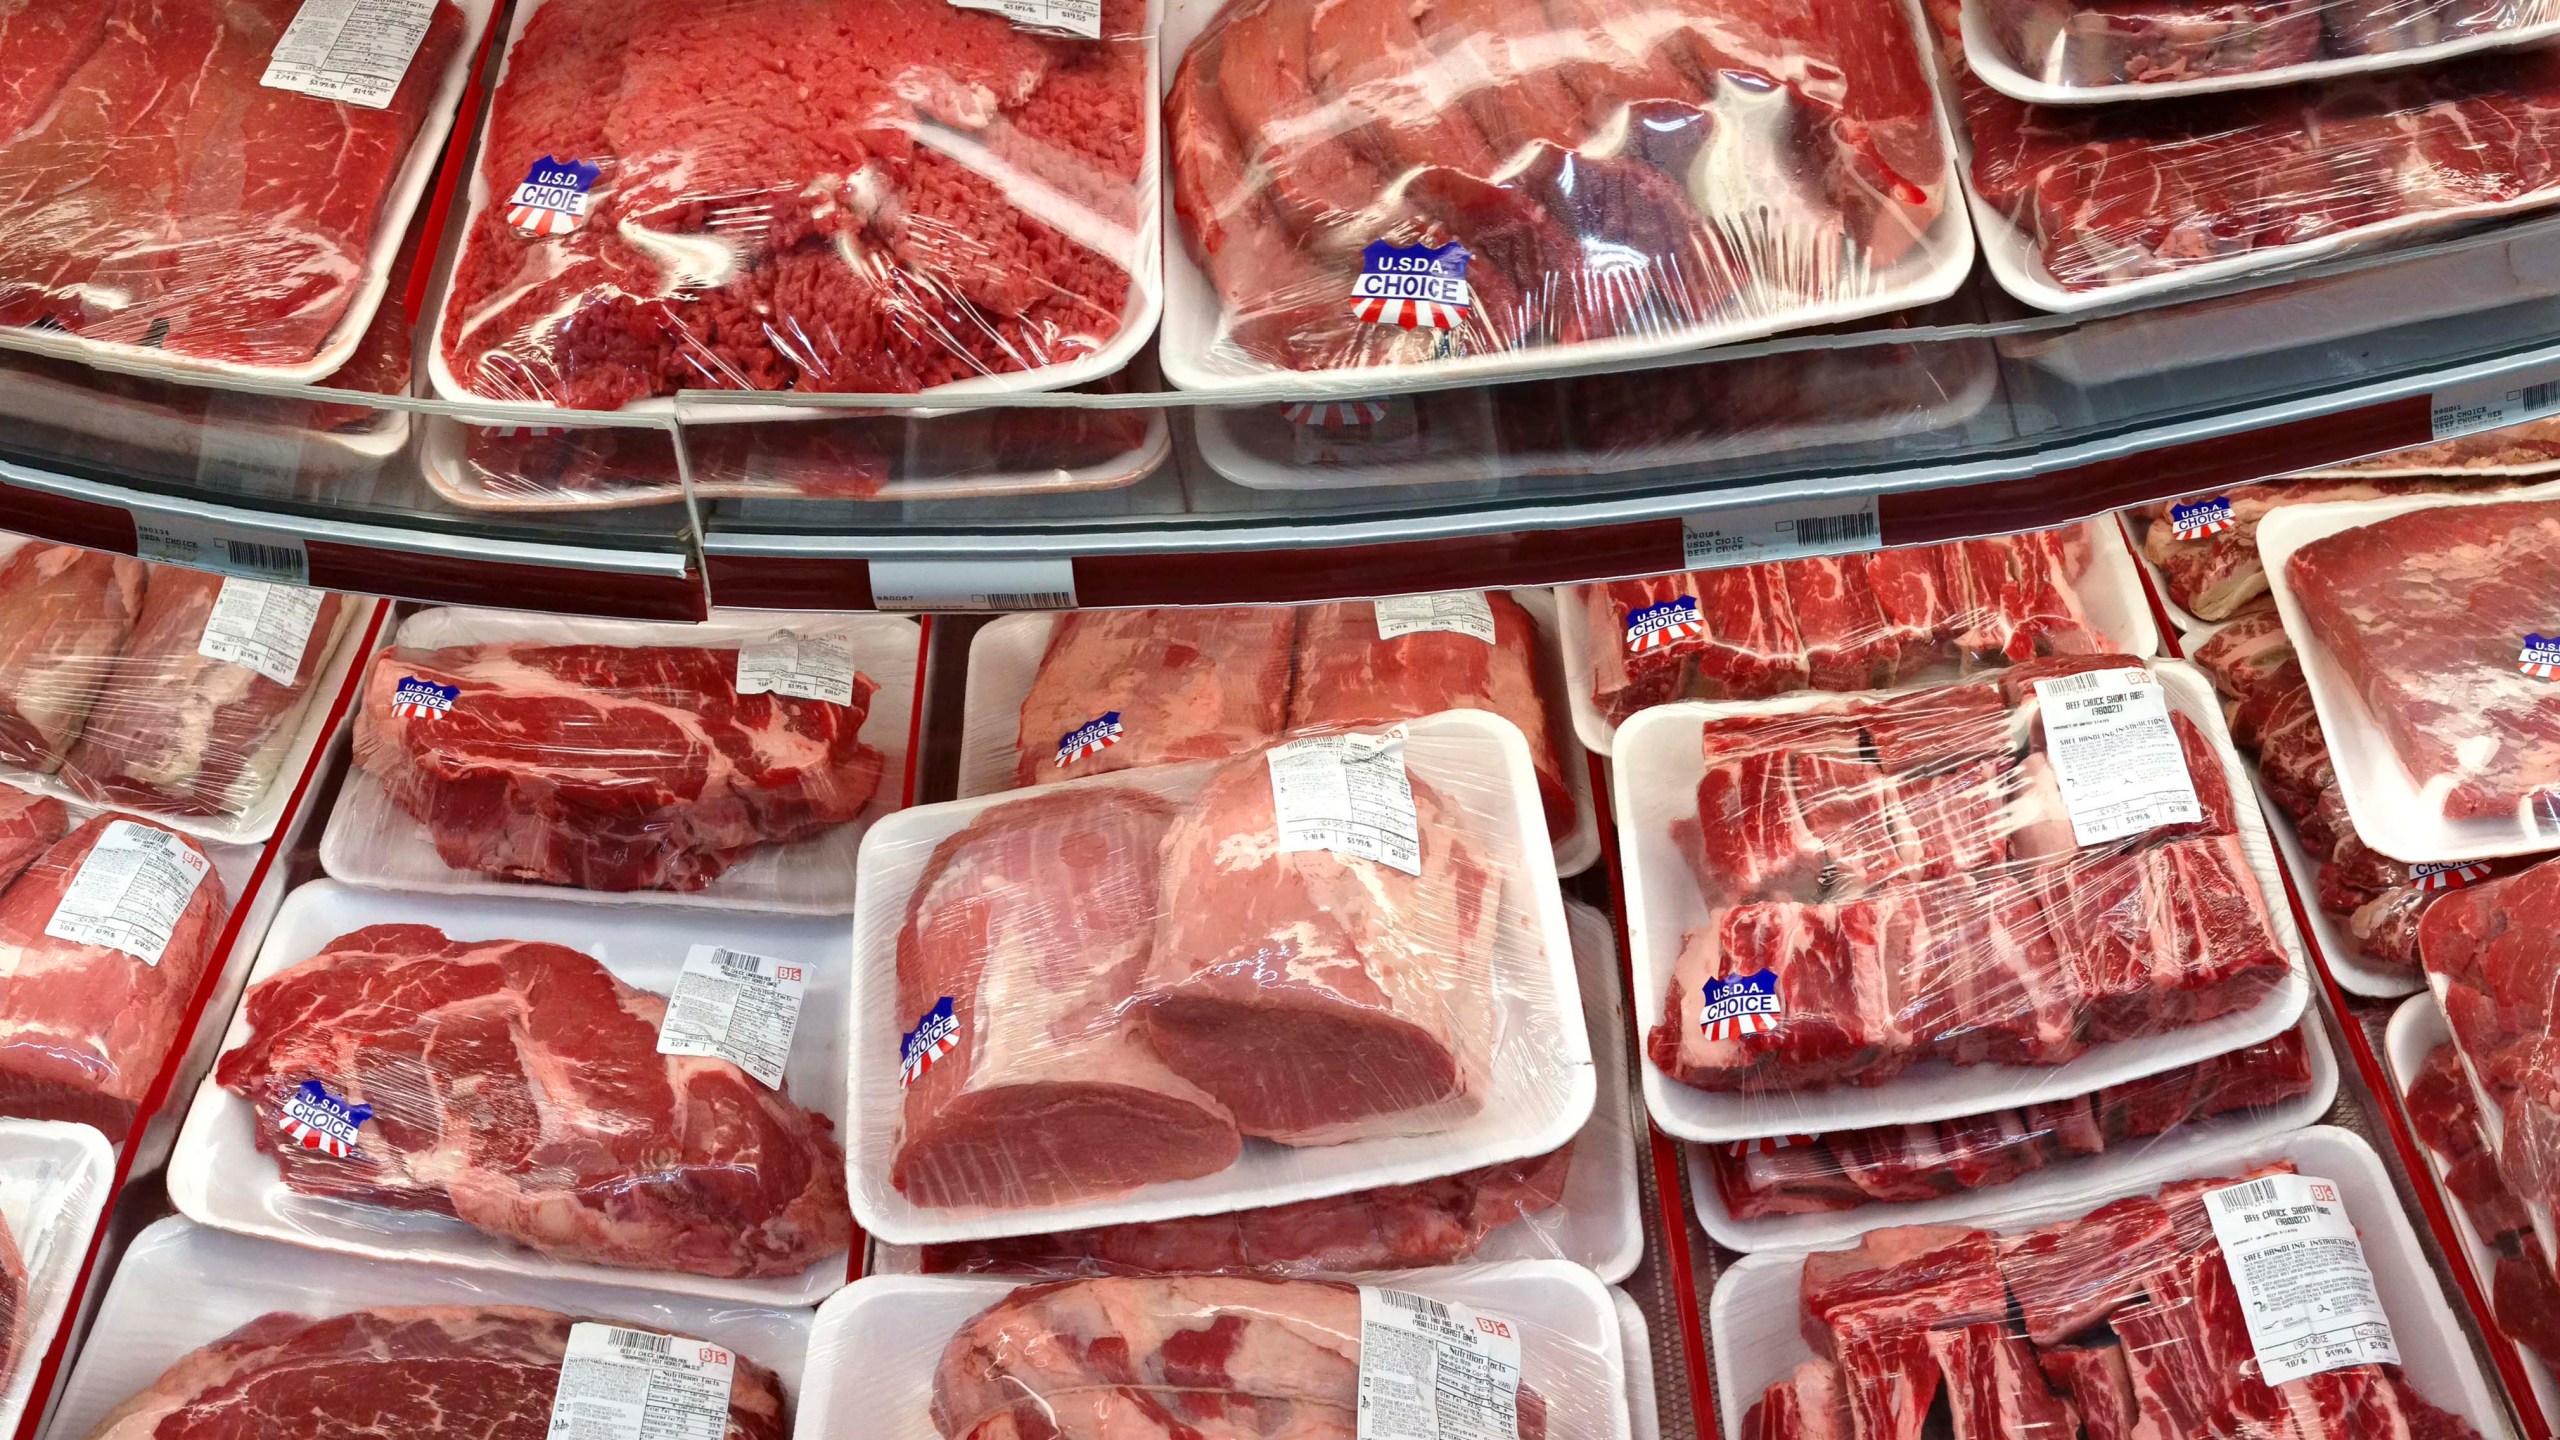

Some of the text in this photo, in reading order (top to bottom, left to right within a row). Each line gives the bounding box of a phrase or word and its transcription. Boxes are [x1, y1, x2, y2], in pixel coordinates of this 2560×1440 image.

[1364, 275, 1459, 301] CHOICE
[2434, 406, 2487, 424] USDA CHOICE
[2457, 414, 2483, 424] CHUCK
[2179, 510, 2229, 529] CHOICE
[2181, 504, 2222, 518] U.S.D.A.
[165, 537, 198, 549] CHOICE
[1687, 540, 1711, 549] USDA
[1687, 547, 1712, 557] BEEF
[1637, 604, 1686, 622] U.S.D.A.
[1634, 611, 1695, 636] CHOICE
[2535, 642, 2560, 652] U.S.
[404, 683, 445, 698] U.S.D.A.
[396, 692, 448, 709] CHOICE
[2066, 700, 2081, 710] BEEF
[2083, 697, 2104, 707] CHUCK
[1062, 724, 1116, 755] CHOICE
[1067, 721, 1109, 743] U.S.D.A.
[778, 966, 801, 982] BJ's
[1713, 982, 1764, 1001] U.S.D.A.
[1707, 996, 1772, 1020] CHOICE
[905, 1018, 952, 1070] CHOICE
[293, 1103, 354, 1141] CHOICE
[2311, 1184, 2336, 1202] BJ's
[2244, 1252, 2261, 1263] SAFE
[2310, 1239, 2356, 1248] INSTRUCTIONS
[1476, 1317, 1512, 1339] BJ's
